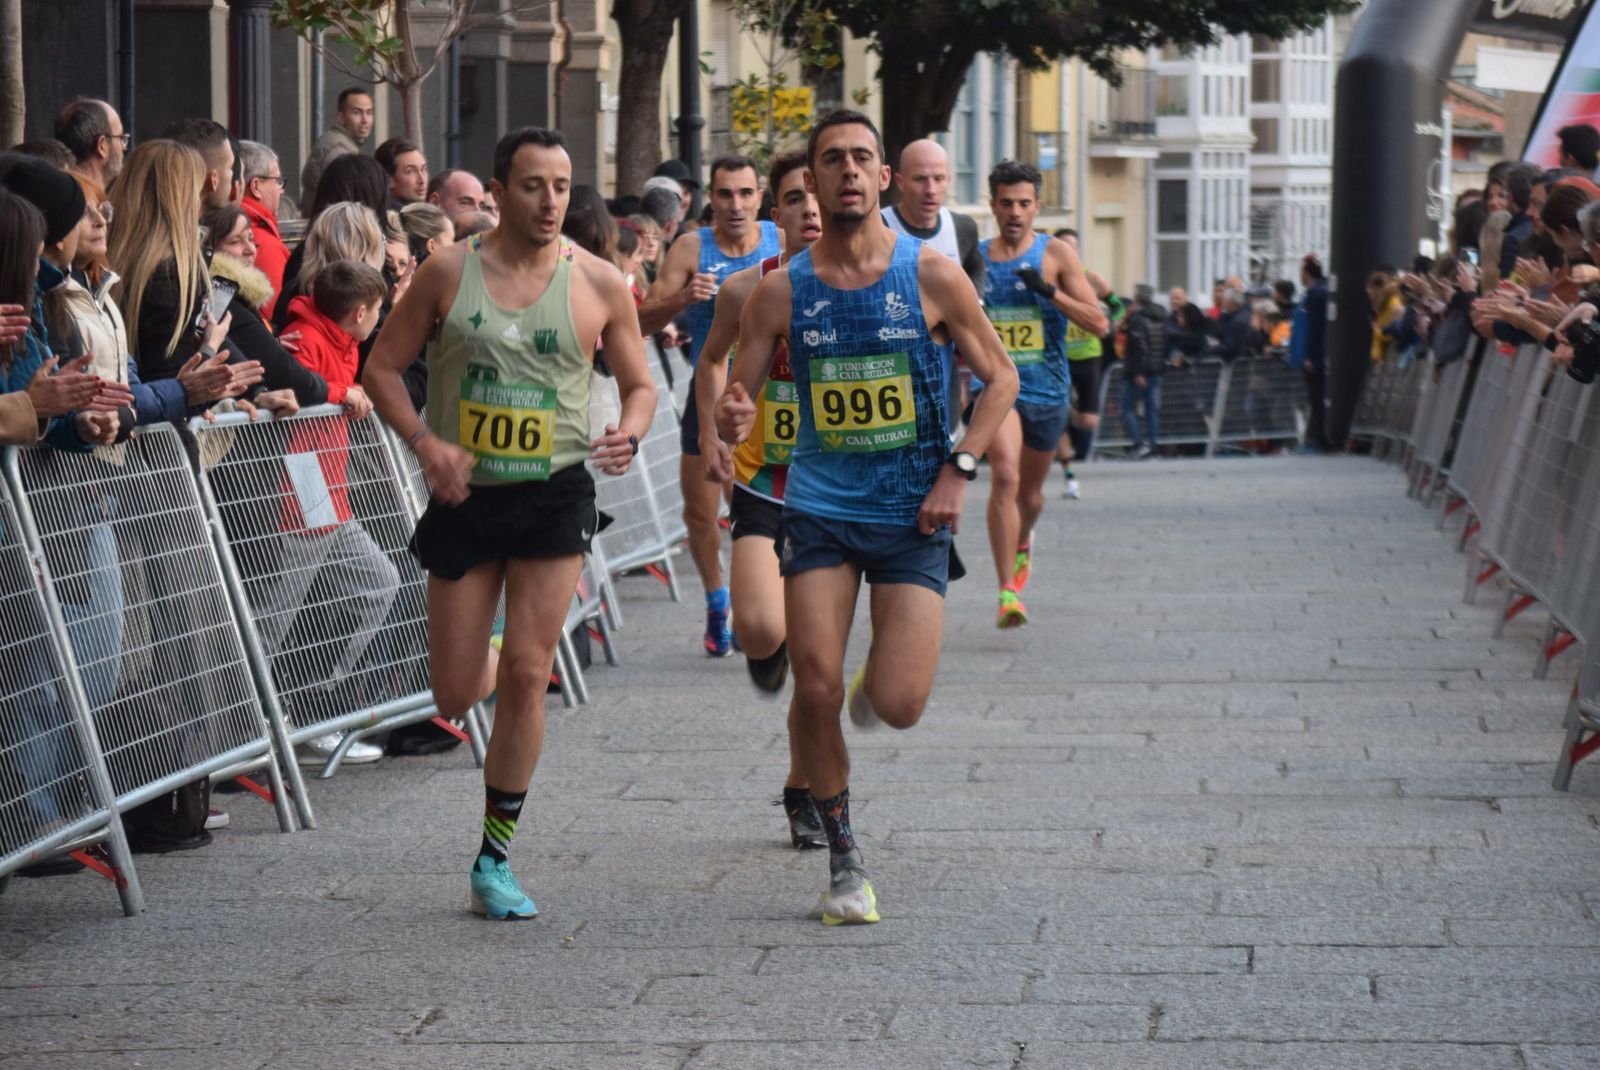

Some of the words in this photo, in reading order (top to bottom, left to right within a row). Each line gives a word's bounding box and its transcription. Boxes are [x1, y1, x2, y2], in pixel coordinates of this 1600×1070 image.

[863, 368, 896, 379] RURAL
[511, 398, 543, 409] RURAL
[822, 385, 902, 426] 996
[468, 408, 541, 452] 706
[846, 435, 872, 445] CAJA
[874, 429, 912, 444] RURAL
[508, 461, 545, 473] RURAL
